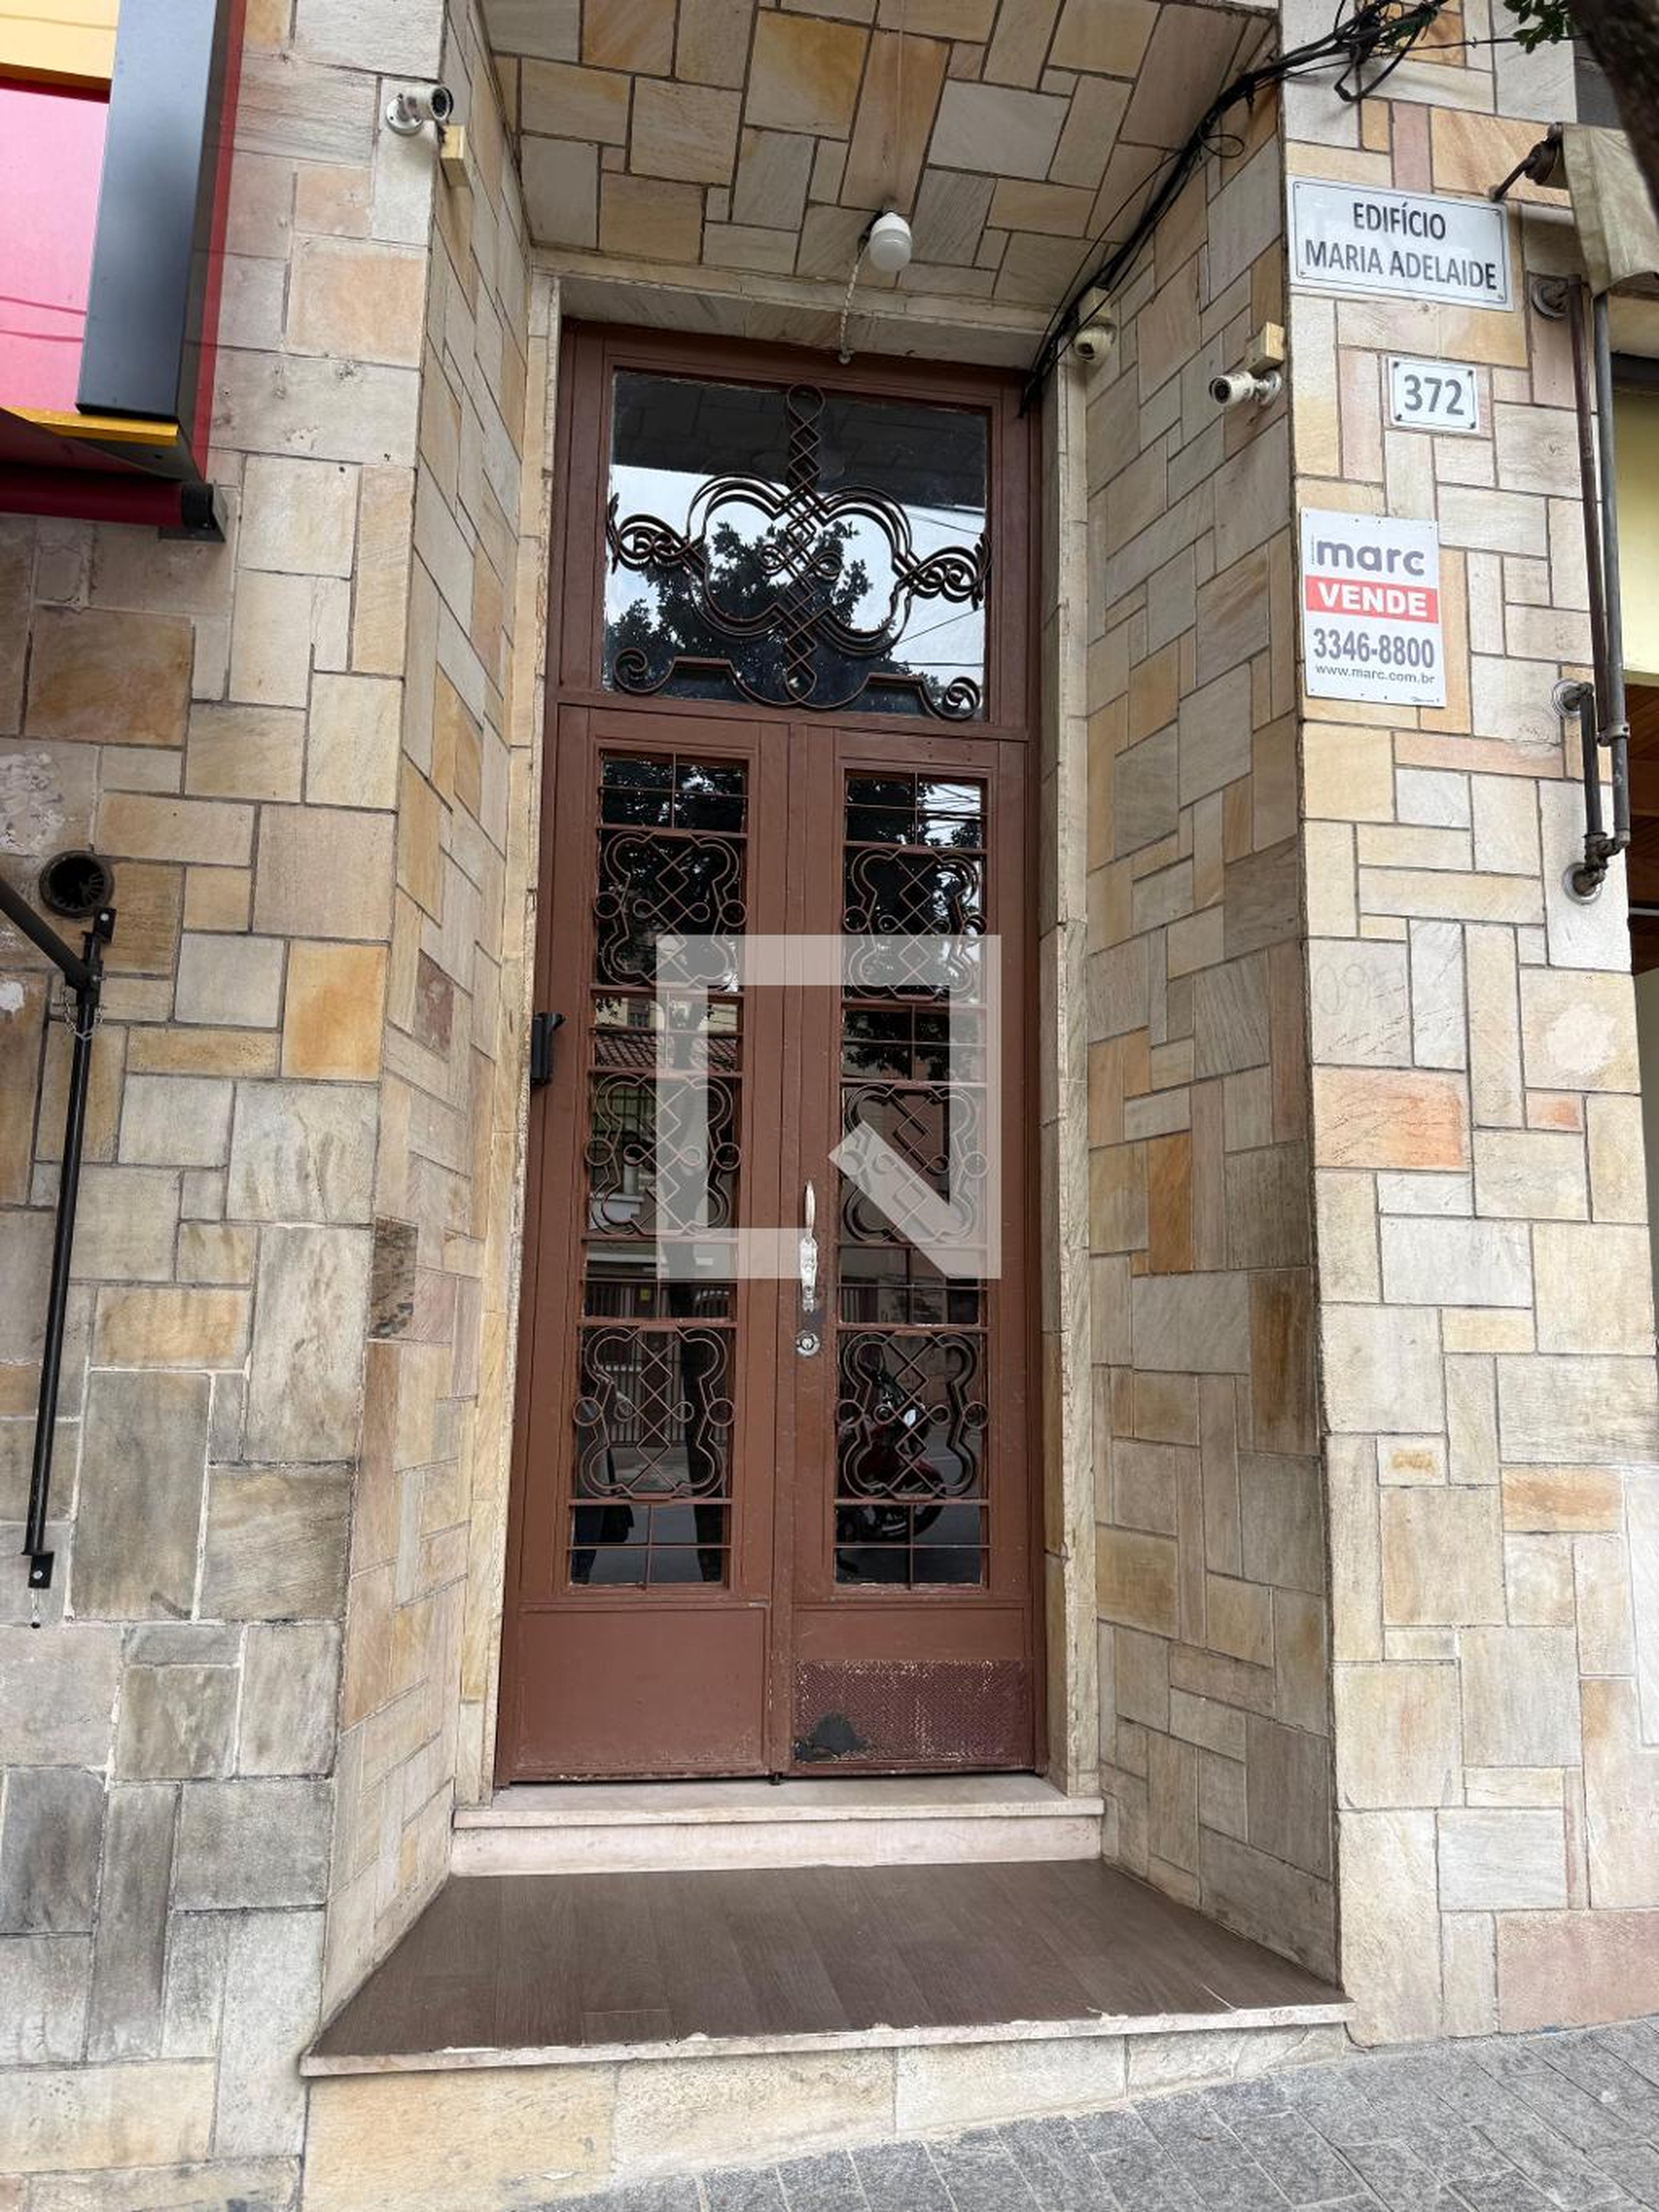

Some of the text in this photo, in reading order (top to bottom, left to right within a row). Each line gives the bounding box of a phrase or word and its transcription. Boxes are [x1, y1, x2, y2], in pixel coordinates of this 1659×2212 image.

[1353, 202, 1446, 240] EDIFÍCIO
[1305, 239, 1497, 290] MARIA ADELAIDE
[1404, 374, 1465, 416] 372
[1316, 540, 1425, 576] marc
[1318, 582, 1428, 617] VENDE
[1313, 628, 1434, 668] 3346-8800
[1316, 665, 1435, 684] www.marc.com.br
